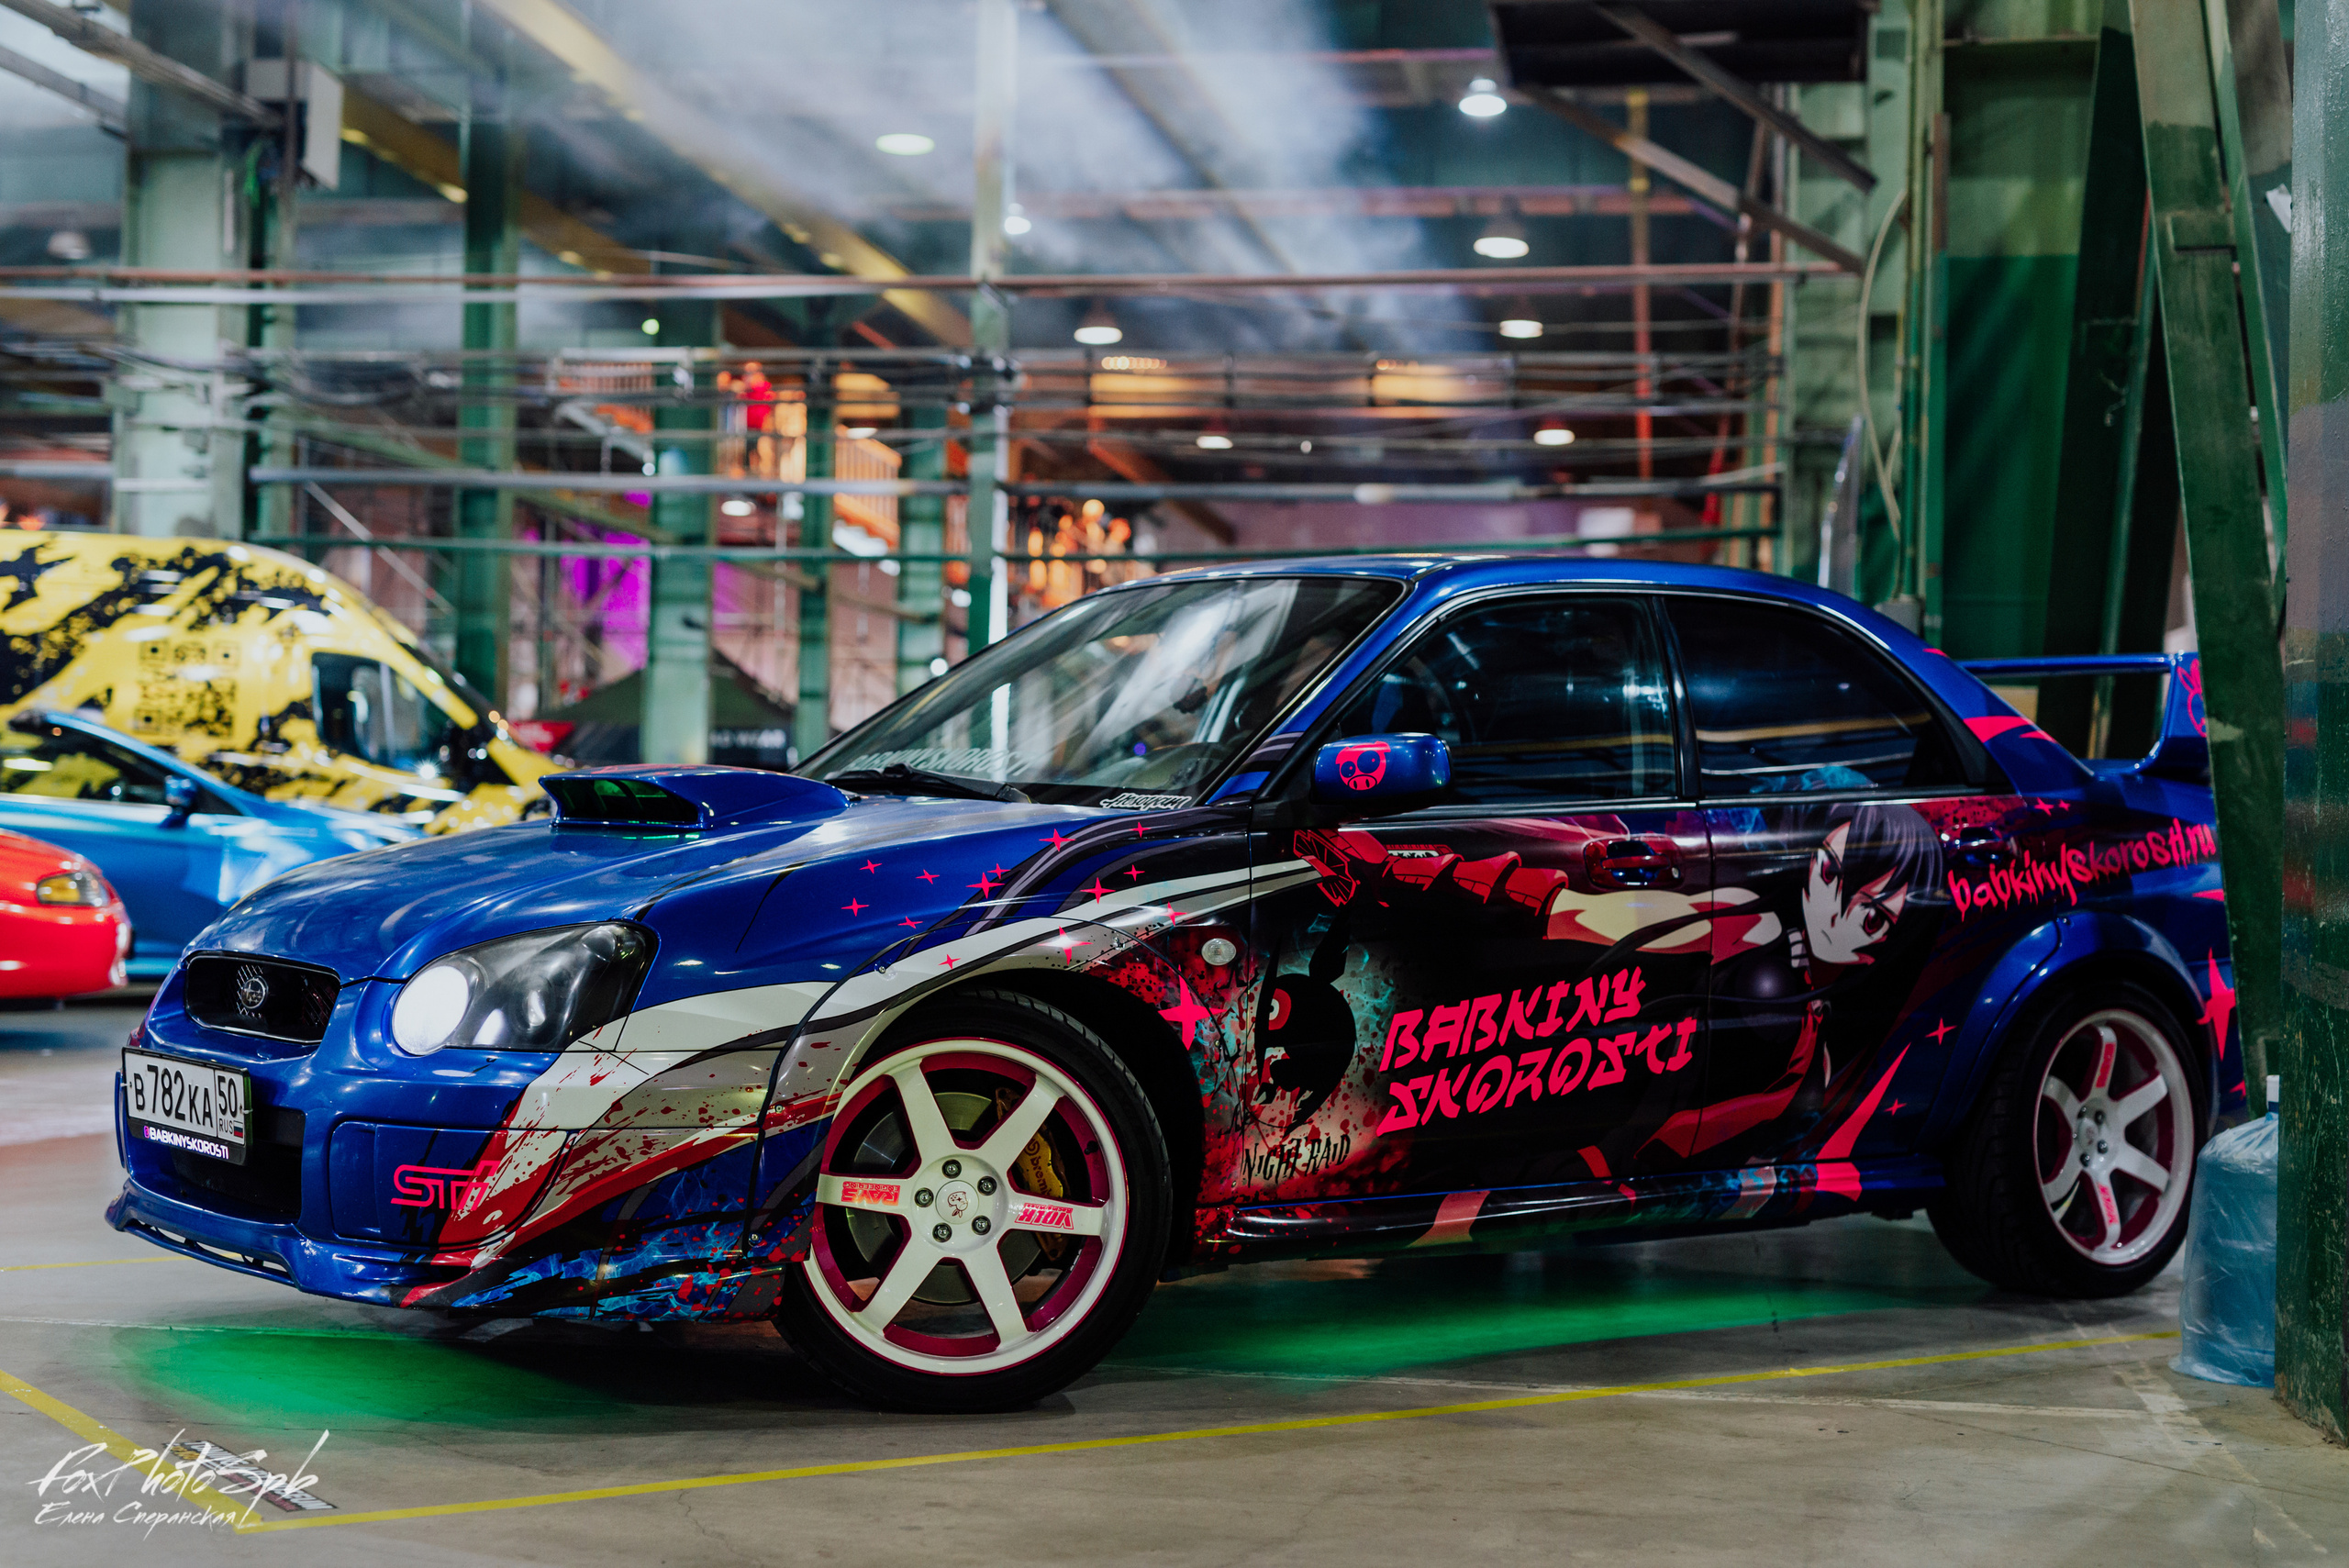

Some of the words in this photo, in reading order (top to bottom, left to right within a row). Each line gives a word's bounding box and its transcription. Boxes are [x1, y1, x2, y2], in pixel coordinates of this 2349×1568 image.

[1378, 966, 1647, 1072] BABKINY
[1376, 1017, 1698, 1137] SKOROSTI
[217, 1075, 238, 1118] 50
[219, 1118, 233, 1134] RUS
[841, 1189, 900, 1207] RAYS
[1014, 1208, 1074, 1229] VOLK
